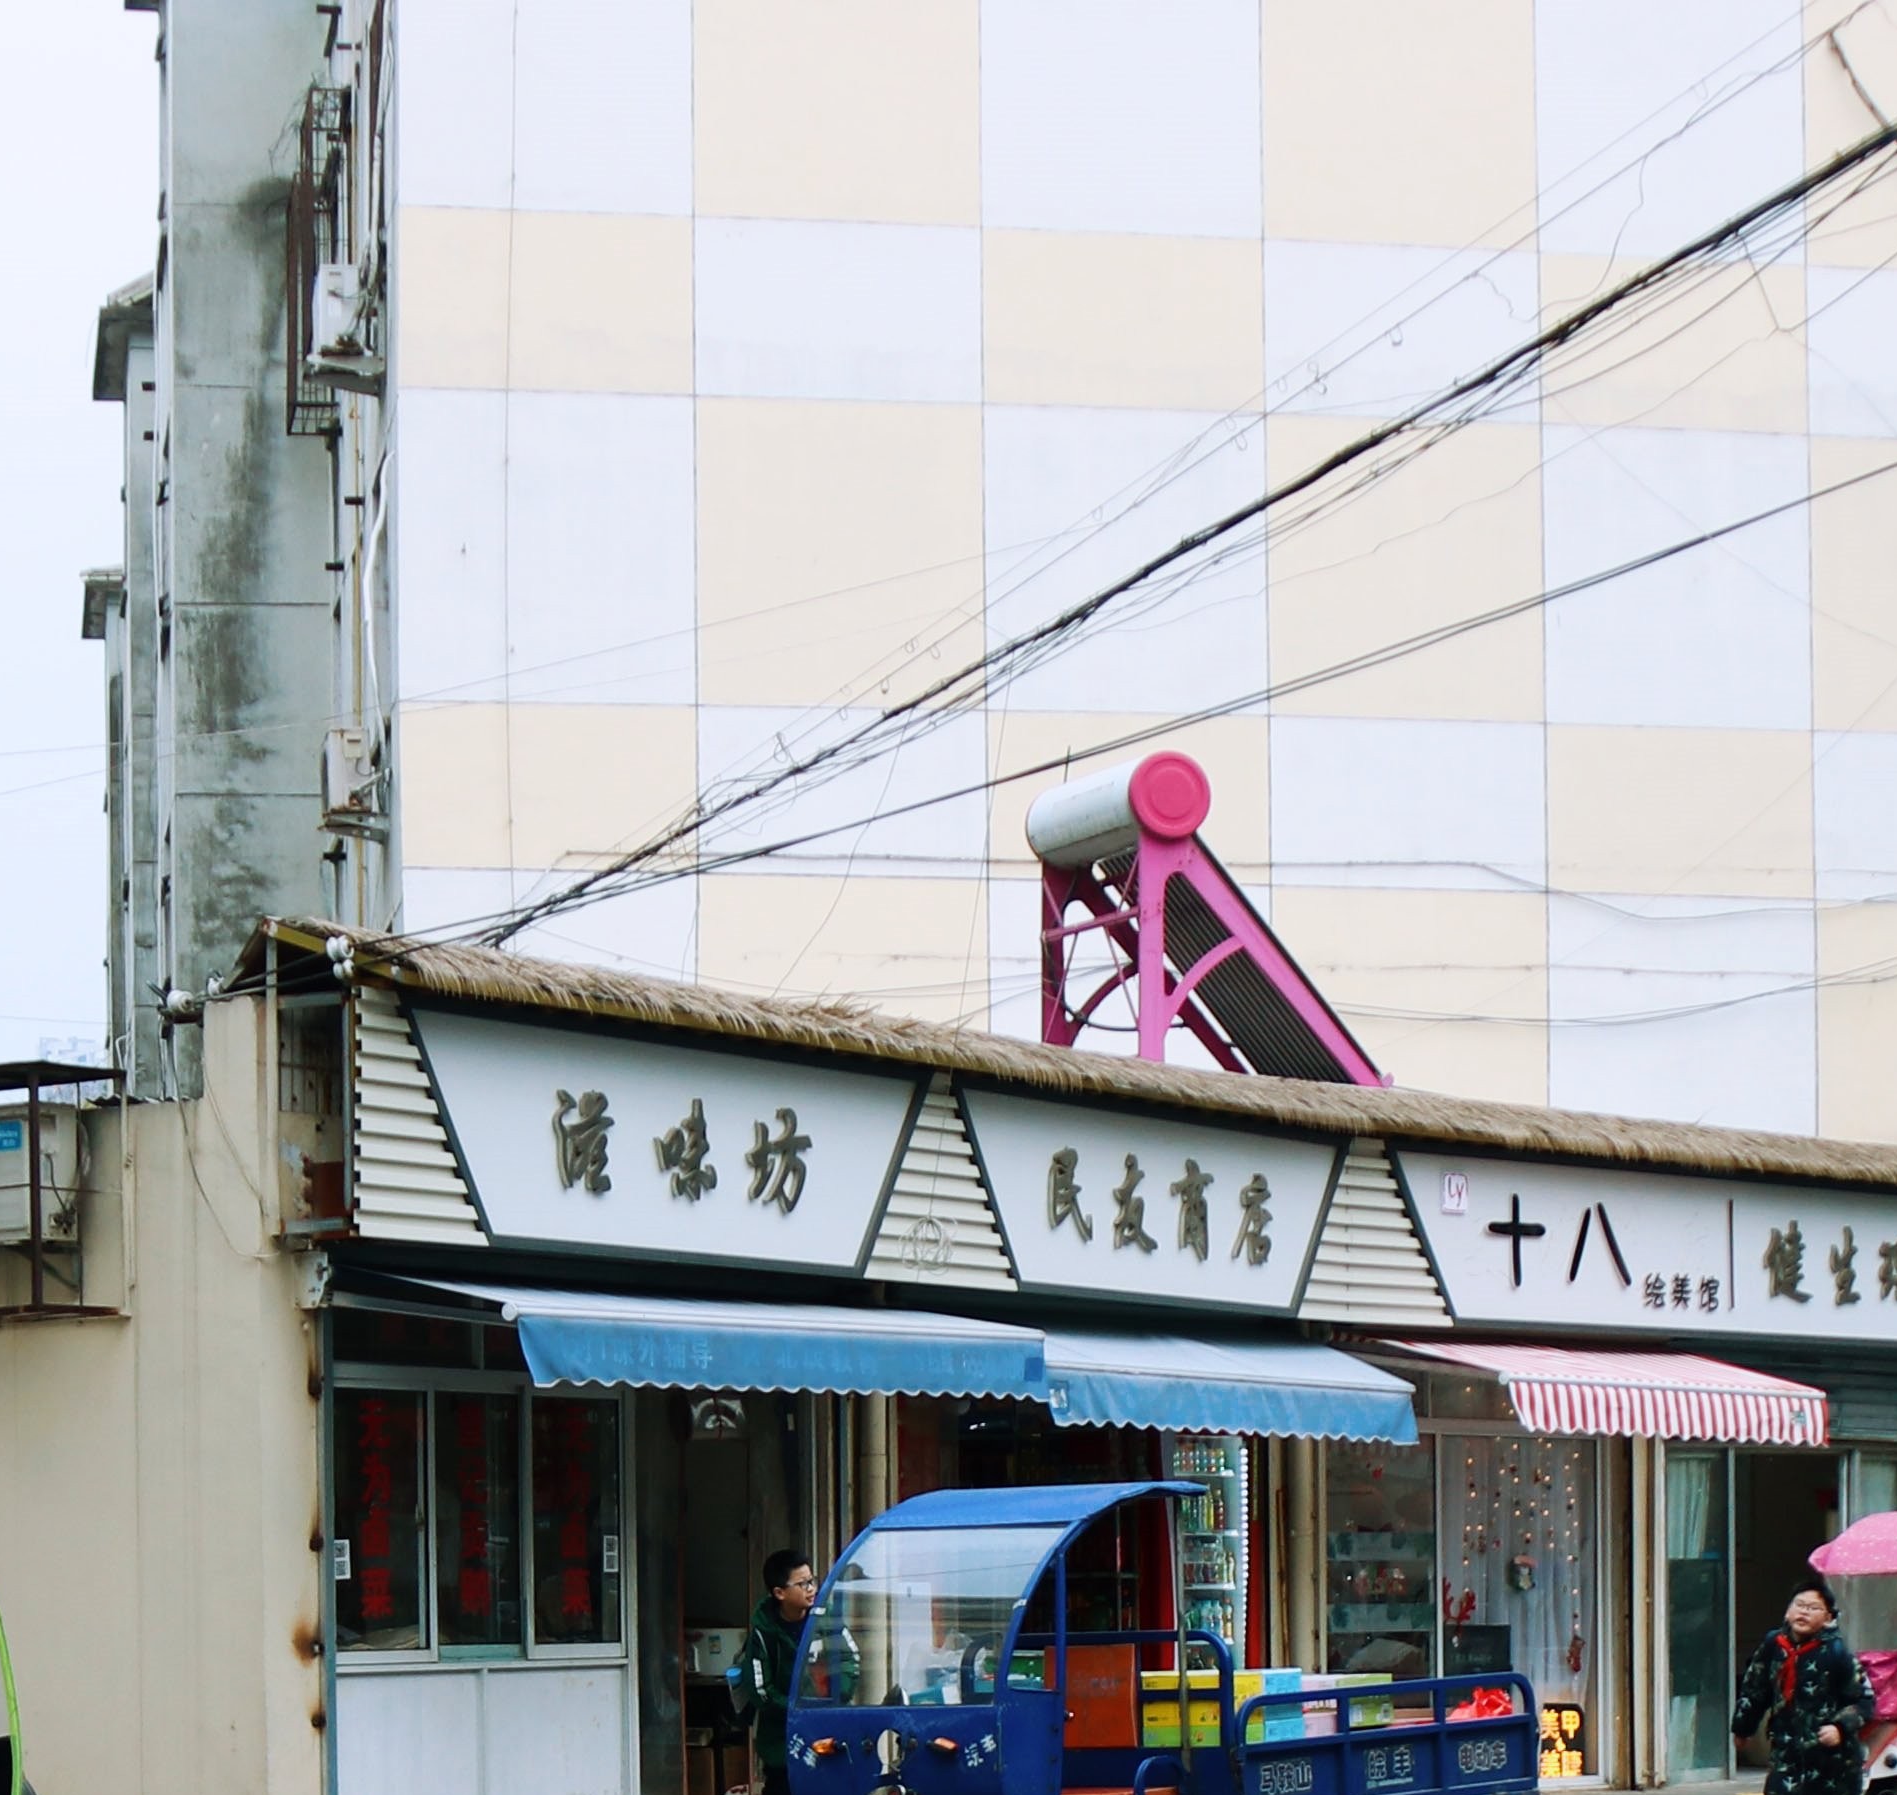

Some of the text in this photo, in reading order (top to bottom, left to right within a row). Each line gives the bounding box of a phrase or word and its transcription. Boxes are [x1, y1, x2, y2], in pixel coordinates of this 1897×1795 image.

[551, 1088, 813, 1215] 滋味坊
[1488, 1193, 1632, 1288] 十八
[1644, 1272, 1720, 1313] 绘美馆
[1259, 1760, 1313, 1795] 马鞍山
[1458, 1740, 1508, 1774] 电动车
